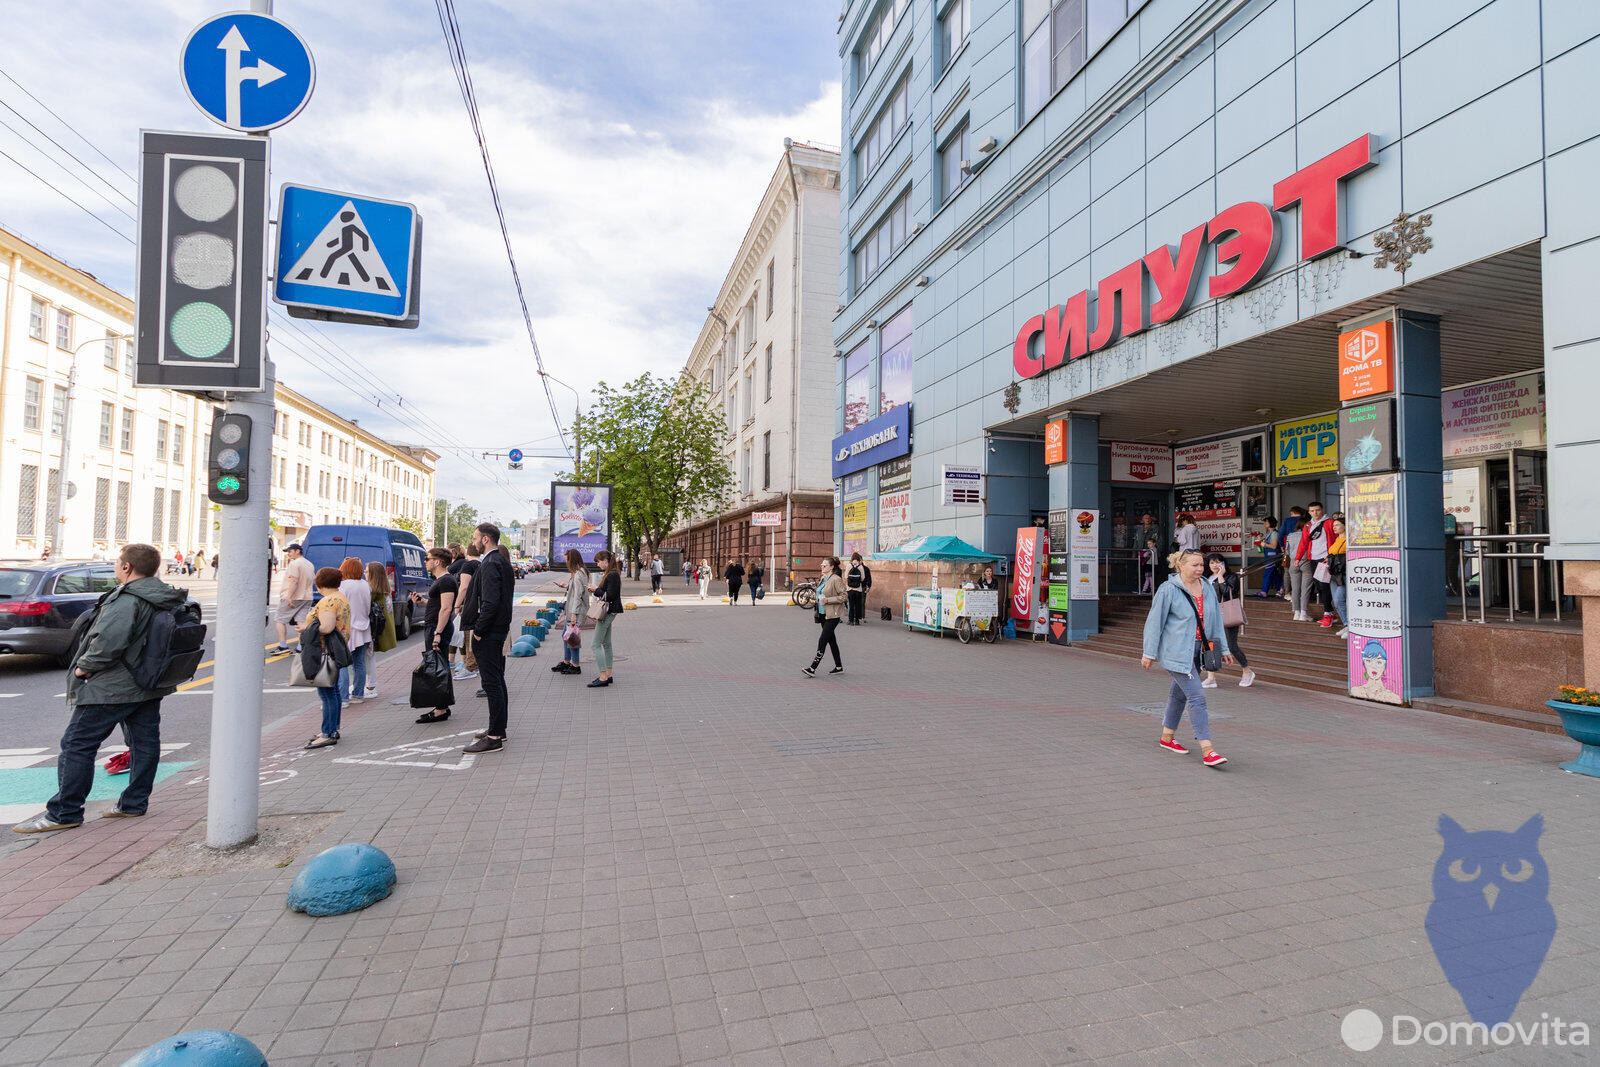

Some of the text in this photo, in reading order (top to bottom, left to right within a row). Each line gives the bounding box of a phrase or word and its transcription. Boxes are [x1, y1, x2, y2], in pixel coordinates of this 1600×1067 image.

[1013, 133, 1379, 379] СИЛУЭТ
[1342, 358, 1382, 376] ДОМА ТВ
[1463, 380, 1516, 397] СПОРТИВНАЯ
[1451, 387, 1530, 409] ЖЕНСКАЯ ОДЕЖДА
[1461, 400, 1520, 418] ДЛЯ ФИТНЕСА
[1446, 406, 1538, 429] И АКТИВНОГО ОТДЫХА
[850, 425, 899, 456] ТЕХНОБАНК
[1115, 444, 1149, 452] Торговые
[1175, 443, 1220, 457] РЕМОНТ МОБИЛЬНЫХ
[1185, 453, 1209, 462] ТЕЛЕФОНОВ
[1132, 464, 1153, 475] ВХОД
[881, 493, 910, 509] ЛОМБАРД
[1194, 523, 1226, 531] орговые
[1200, 531, 1241, 541] ний уро
[1014, 534, 1034, 615] Coca-Cola
[1353, 566, 1393, 574] СТУДИЯ
[1349, 576, 1398, 585] КРАСОТЫ
[1357, 599, 1391, 608] 3 этаж
